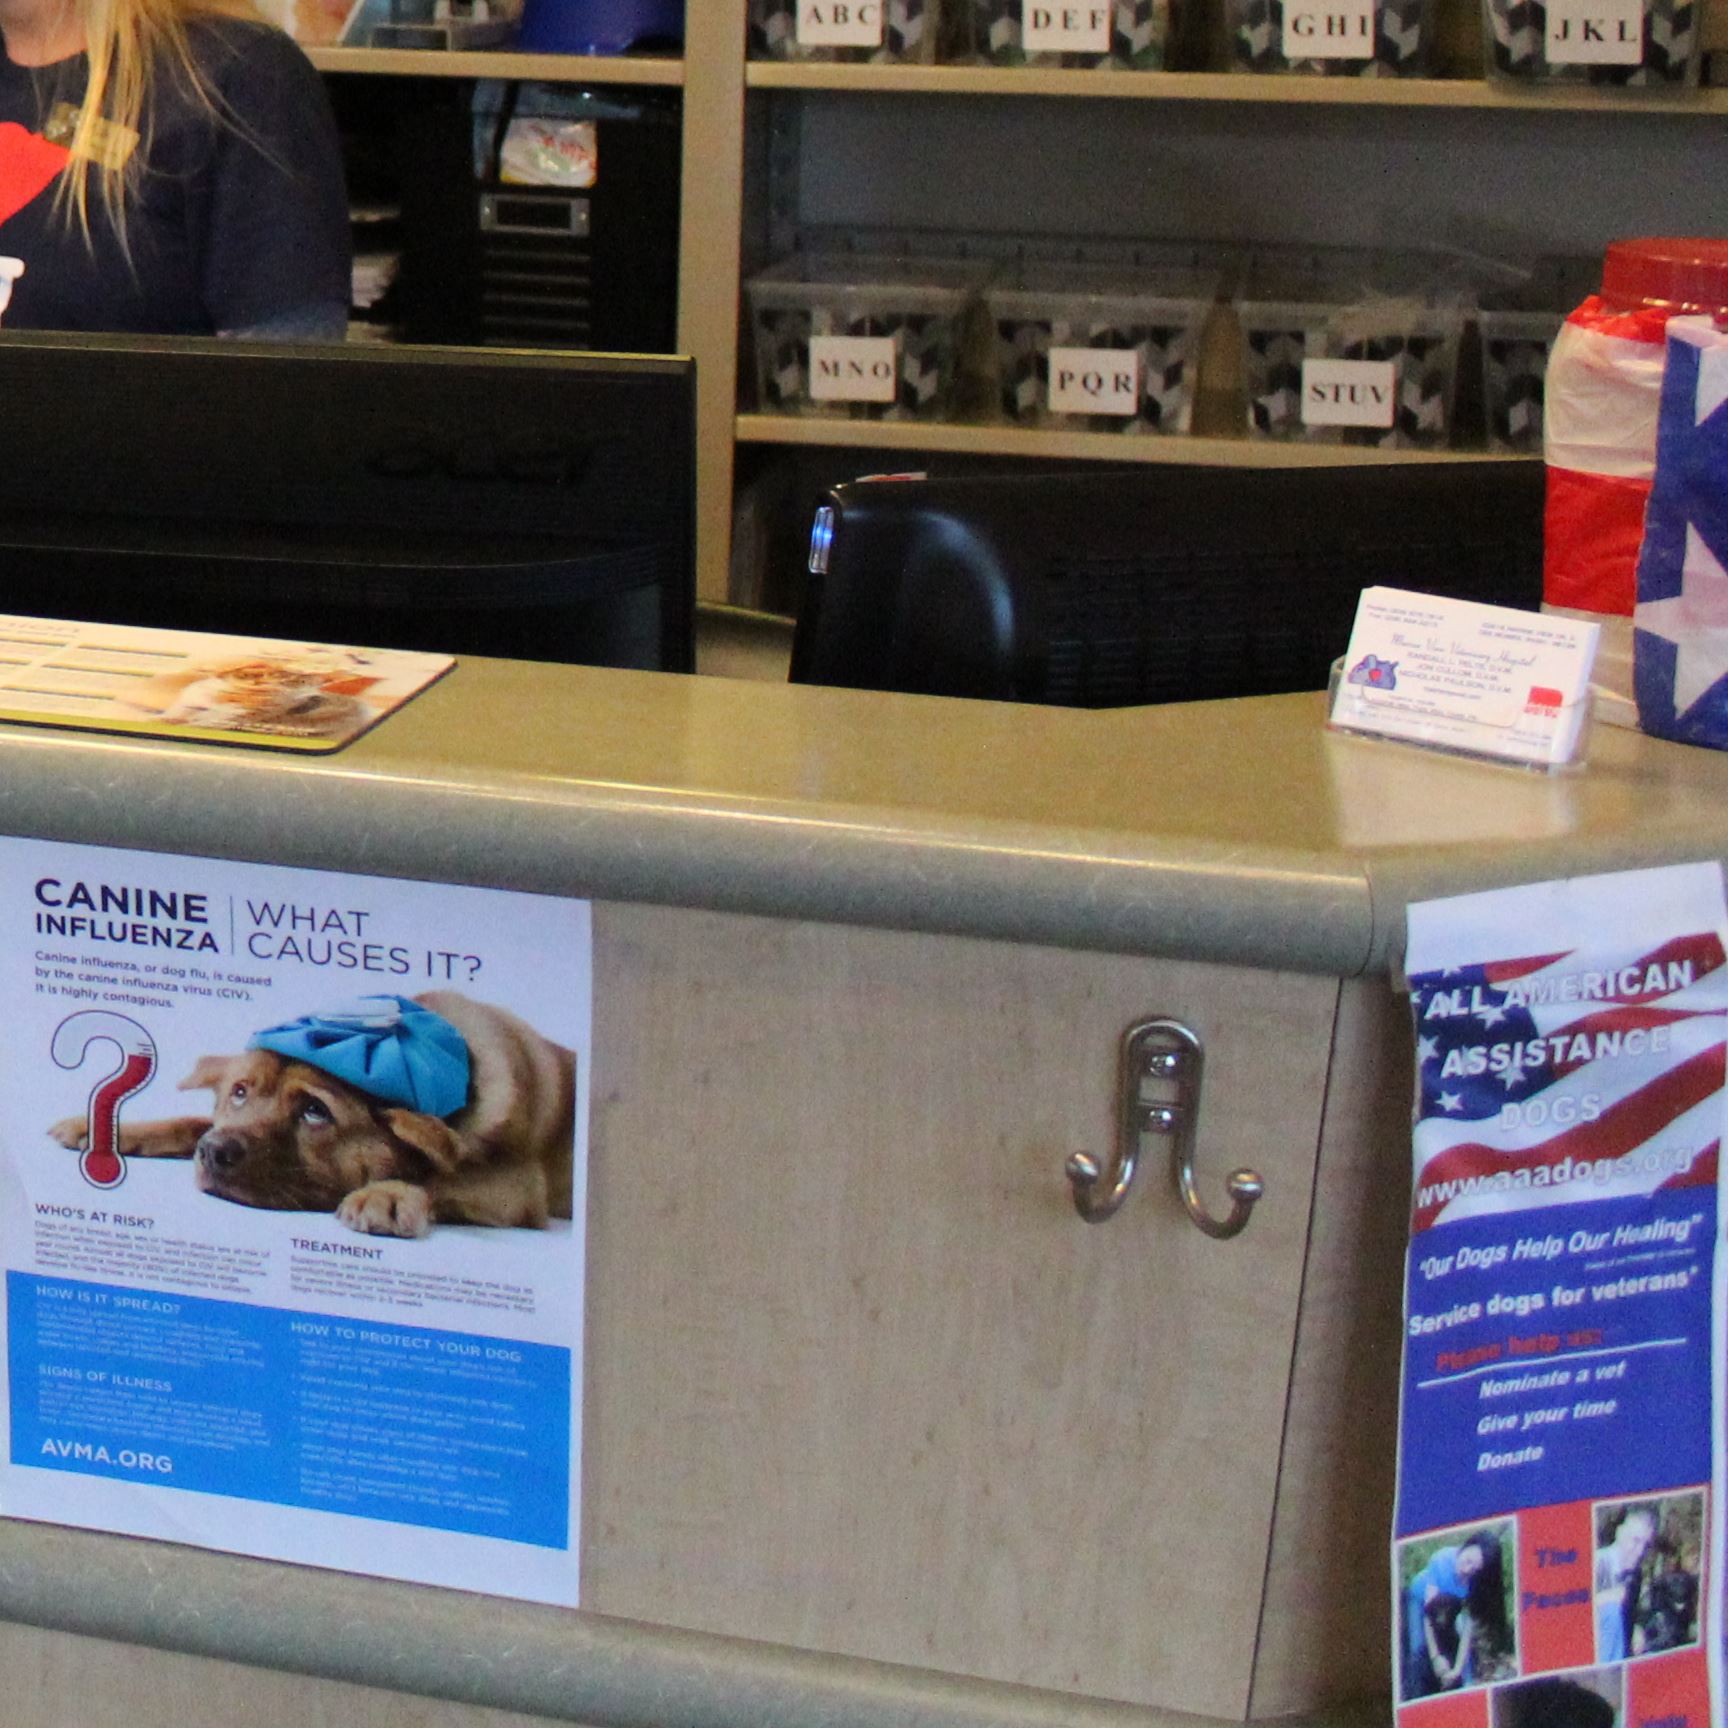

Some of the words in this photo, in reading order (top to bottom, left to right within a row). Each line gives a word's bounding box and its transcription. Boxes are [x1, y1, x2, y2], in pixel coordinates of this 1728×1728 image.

[1311, 382, 1389, 406] STUV
[34, 877, 209, 924] CANINE
[246, 898, 370, 937] WHAT
[36, 913, 220, 954] INFLUENZA
[35, 950, 77, 965] Canine
[81, 954, 140, 973] influenza,
[145, 963, 158, 973] or
[161, 963, 186, 980] dog
[227, 973, 273, 987] caused
[247, 932, 411, 975] CAUSES
[425, 949, 483, 983] IT?
[35, 966, 51, 981] by
[54, 967, 74, 980] the
[78, 971, 118, 985] canine
[122, 975, 178, 993] influenza
[183, 983, 212, 997] virus
[61, 986, 98, 1001] highly
[1424, 985, 1491, 1021] ALL
[1500, 959, 1694, 1011] AMERICAN
[1440, 1026, 1672, 1079] ASSISTANCE
[1500, 1094, 1601, 1133] DOGS
[1417, 1146, 1694, 1210] www.aaadogs.org
[35, 1203, 86, 1221] WHO'S
[90, 1210, 108, 1224] AT
[113, 1213, 155, 1230] RISK?
[290, 1237, 384, 1261] TREATMENT
[1455, 1243, 1508, 1271] Dogs
[1512, 1235, 1565, 1262] Help
[1568, 1229, 1611, 1254] Our
[36, 1284, 74, 1301] HOW
[77, 1291, 91, 1303] IS
[95, 1293, 108, 1304] IT
[113, 1294, 181, 1315] SPREAD?
[1408, 1300, 1481, 1337] Service
[1486, 1292, 1545, 1317] dogs
[1550, 1285, 1586, 1308] for
[291, 1320, 330, 1338] HOW
[334, 1326, 355, 1340] TO
[359, 1329, 432, 1351] PROTECT
[437, 1339, 481, 1358] YOUR
[485, 1348, 523, 1364] DOG
[38, 1363, 82, 1382] SIGNS
[86, 1369, 107, 1383] OF
[111, 1373, 173, 1394] ILLNESS
[1479, 1369, 1571, 1399] Nominate
[1575, 1367, 1591, 1384] a
[1594, 1360, 1628, 1381] vet
[1476, 1415, 1519, 1436] Give
[1521, 1403, 1568, 1432] your
[1571, 1398, 1618, 1420] time
[41, 1437, 173, 1474] AVMA.ORG
[1476, 1445, 1545, 1472] Donate
